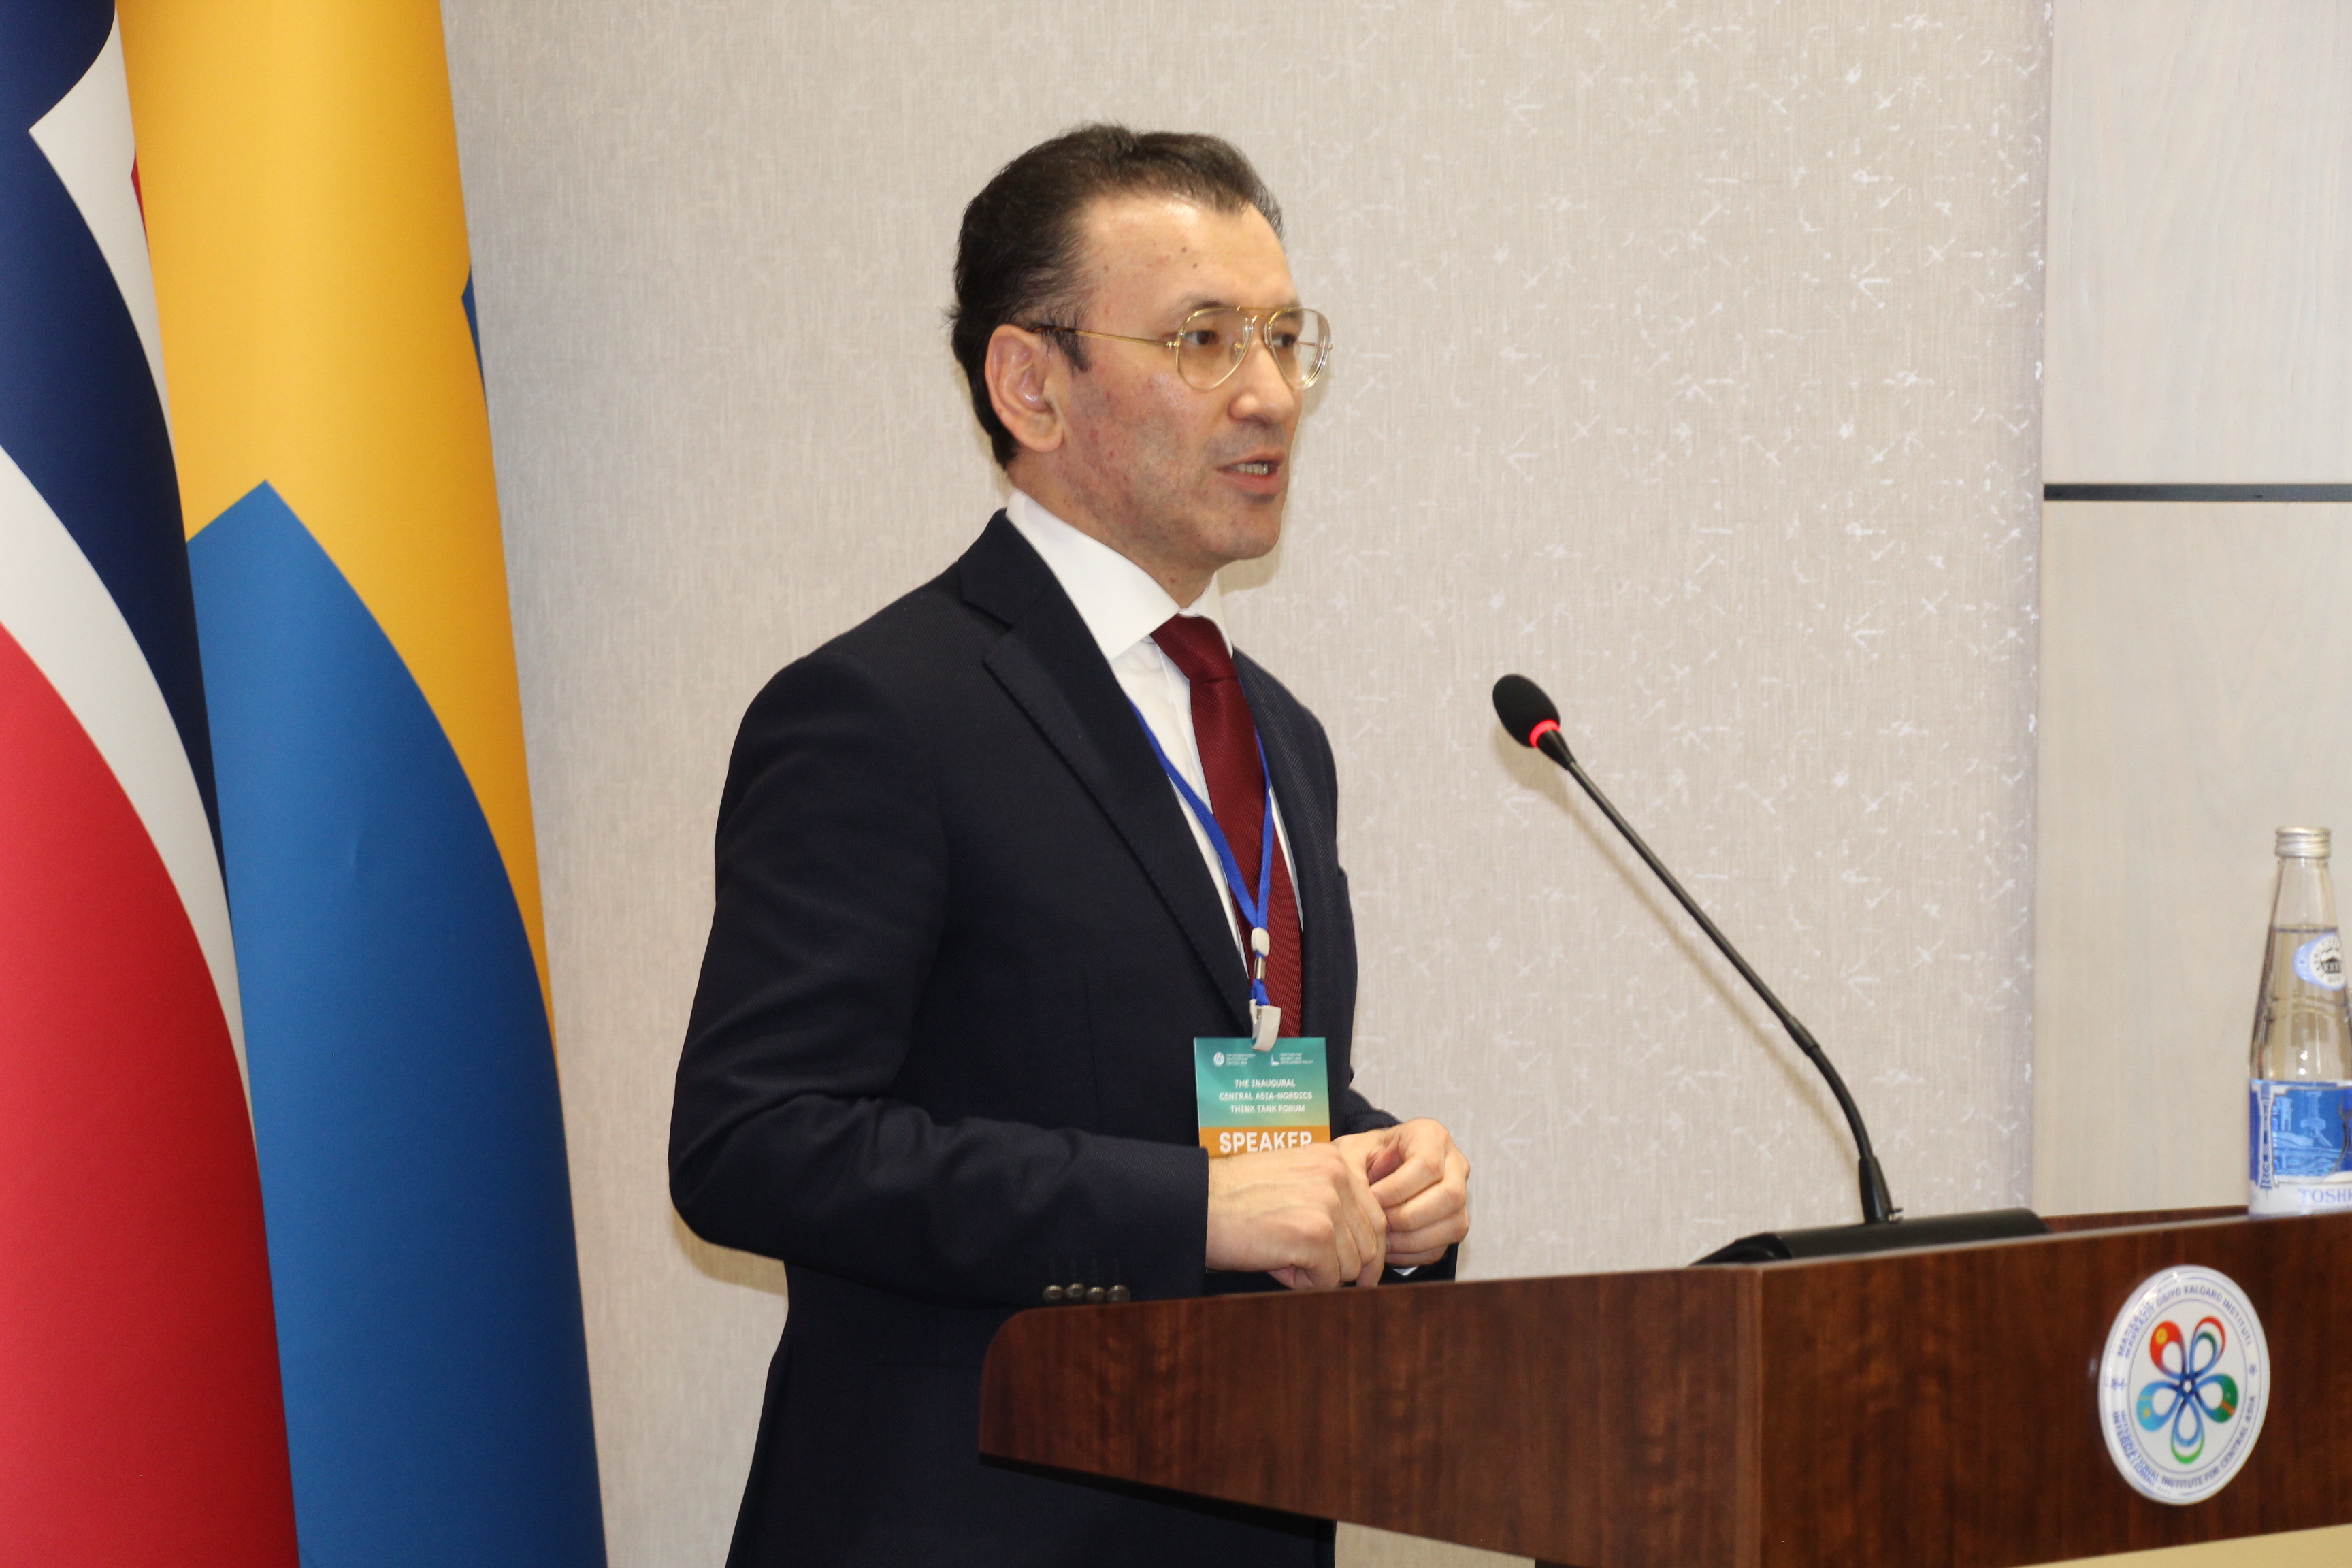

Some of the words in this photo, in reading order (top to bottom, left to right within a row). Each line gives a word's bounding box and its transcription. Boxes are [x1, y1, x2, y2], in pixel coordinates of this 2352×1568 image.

[1235, 1079, 1250, 1088] THE
[1252, 1079, 1296, 1088] INAUGURAL
[1219, 1092, 1254, 1102] CENTRAL
[1256, 1092, 1313, 1101] ASIA-NORDICS
[1230, 1105, 1255, 1114] THINK
[1257, 1105, 1277, 1113] TANK
[1279, 1105, 1305, 1113] FORUM
[1219, 1131, 1312, 1154] SPEAKER
[2161, 1475, 2203, 1488] INSTITUTE
[2204, 1466, 2221, 1482] FOR
[2221, 1426, 2249, 1469] CENTRAL
[2245, 1396, 2256, 1424] ASIA
